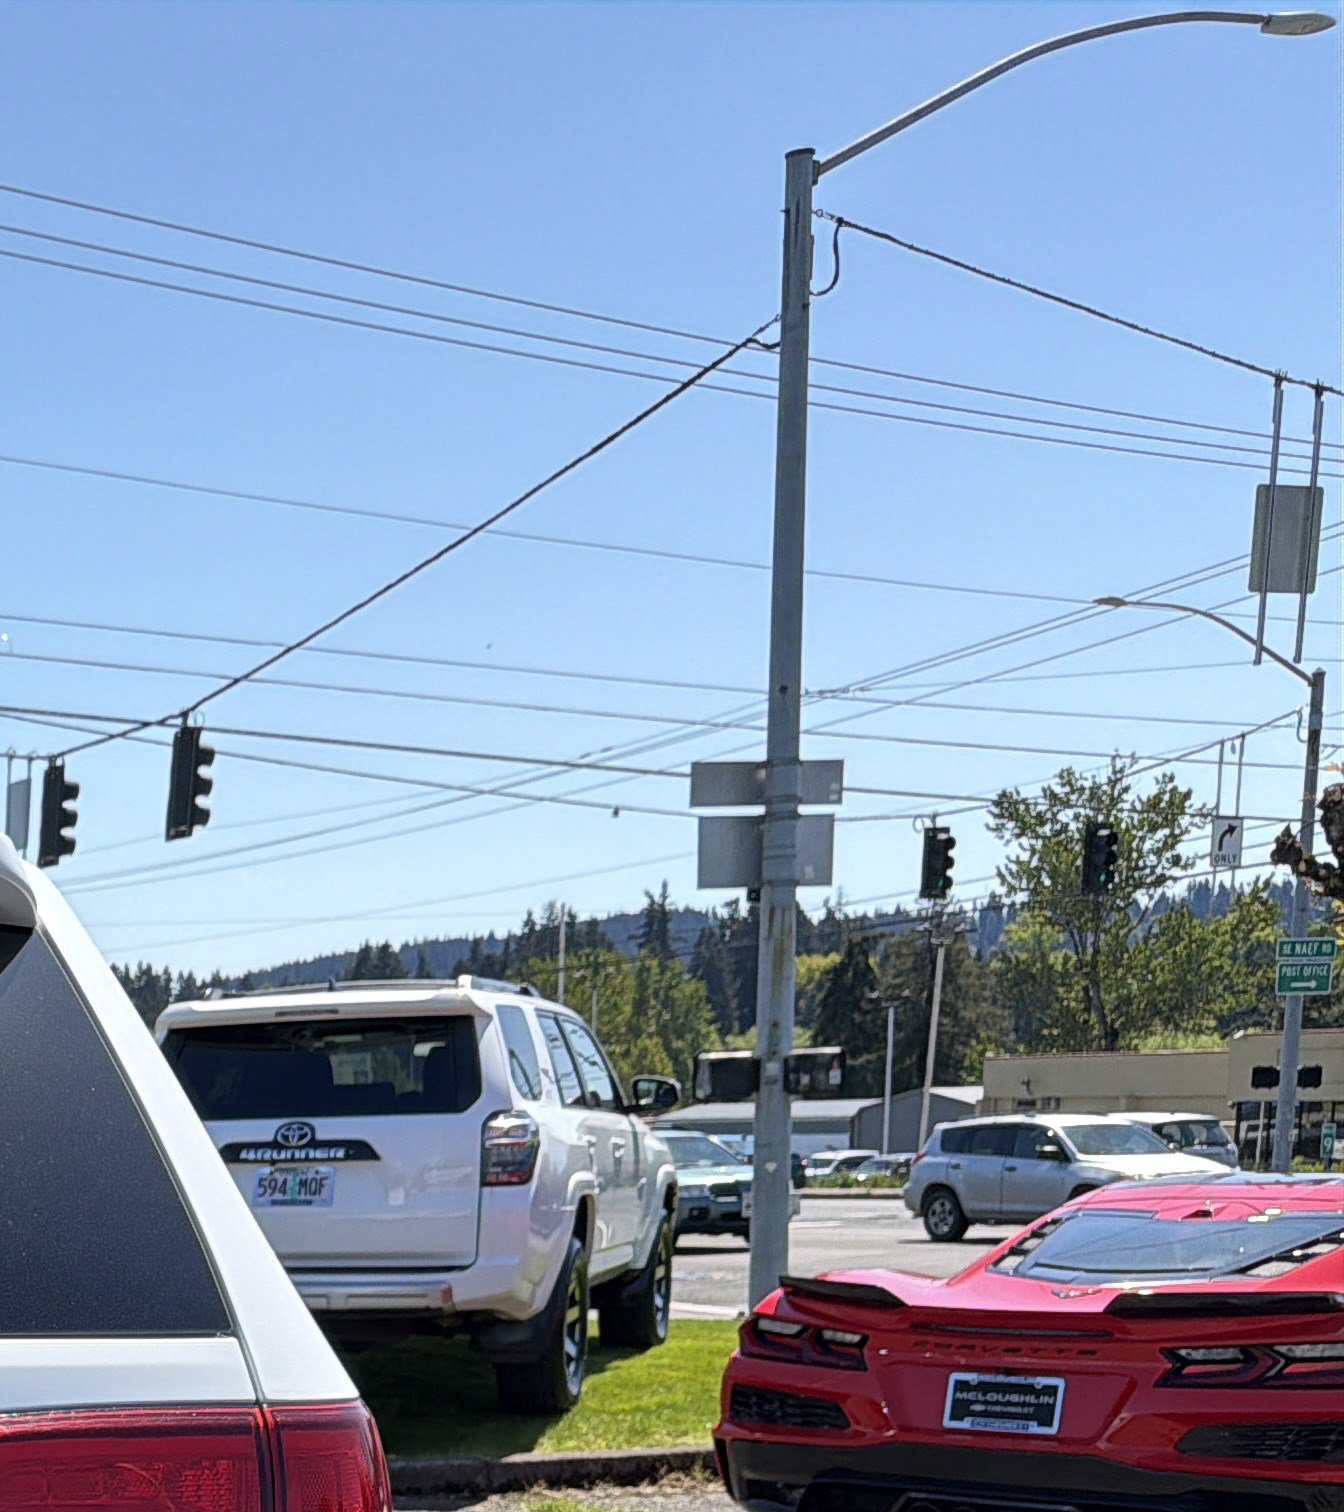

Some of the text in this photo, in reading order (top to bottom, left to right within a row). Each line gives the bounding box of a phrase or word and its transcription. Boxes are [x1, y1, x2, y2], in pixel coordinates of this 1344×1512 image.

[1213, 854, 1238, 865] ONLY
[1281, 965, 1328, 977] POST OFFICE
[258, 1176, 287, 1197] 594
